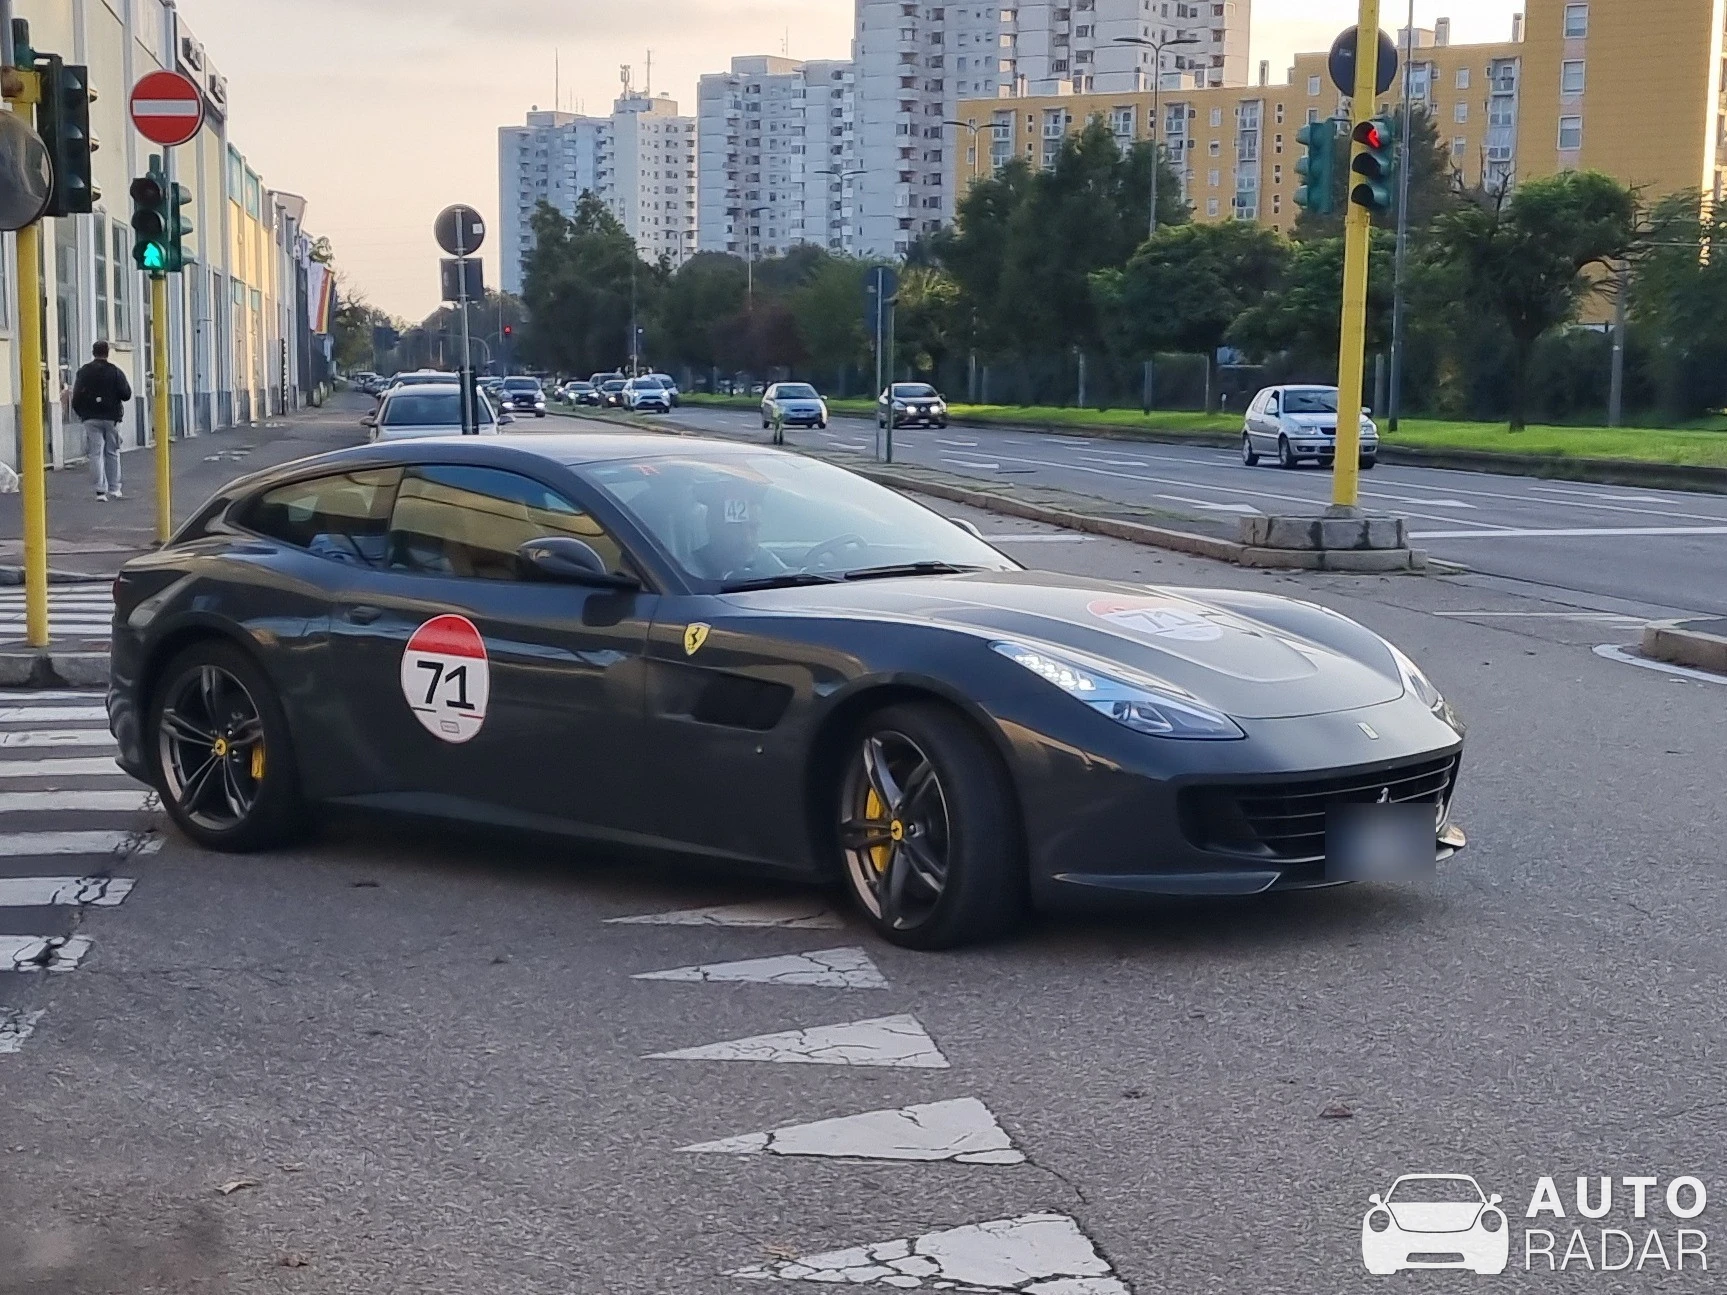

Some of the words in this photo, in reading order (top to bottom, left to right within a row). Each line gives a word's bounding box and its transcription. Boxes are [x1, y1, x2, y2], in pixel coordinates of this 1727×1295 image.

[727, 501, 747, 520] 42
[1118, 610, 1204, 629] 71
[417, 660, 475, 710] 71
